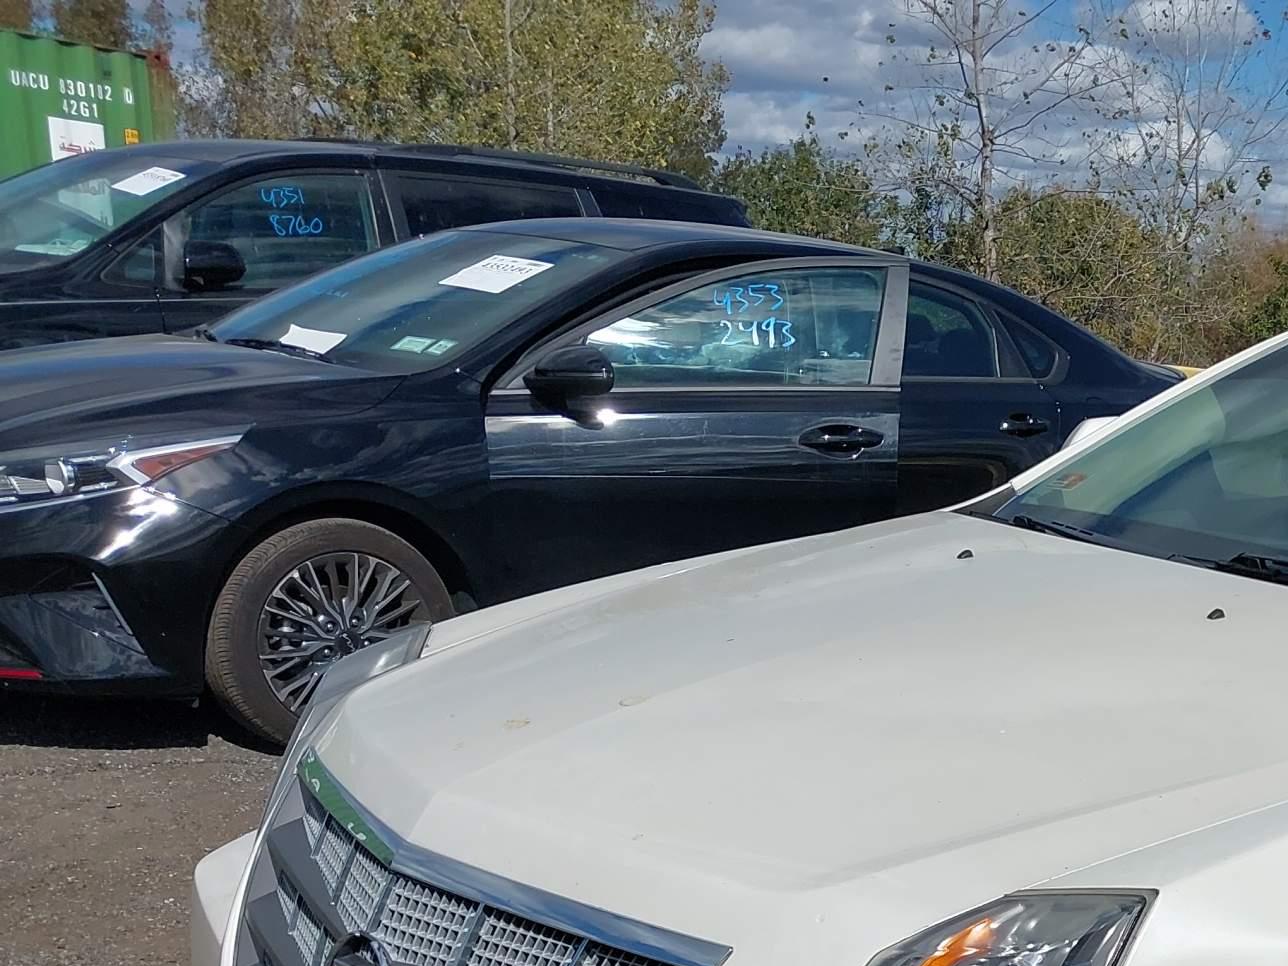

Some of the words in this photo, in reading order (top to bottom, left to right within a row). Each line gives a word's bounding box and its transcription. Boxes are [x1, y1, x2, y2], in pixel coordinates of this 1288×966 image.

[10, 70, 49, 90] UACU
[62, 98, 98, 118] 42G1
[261, 187, 305, 208] 4351
[270, 214, 323, 237] 8760
[713, 283, 784, 315] 4353
[719, 316, 797, 349] 2493
